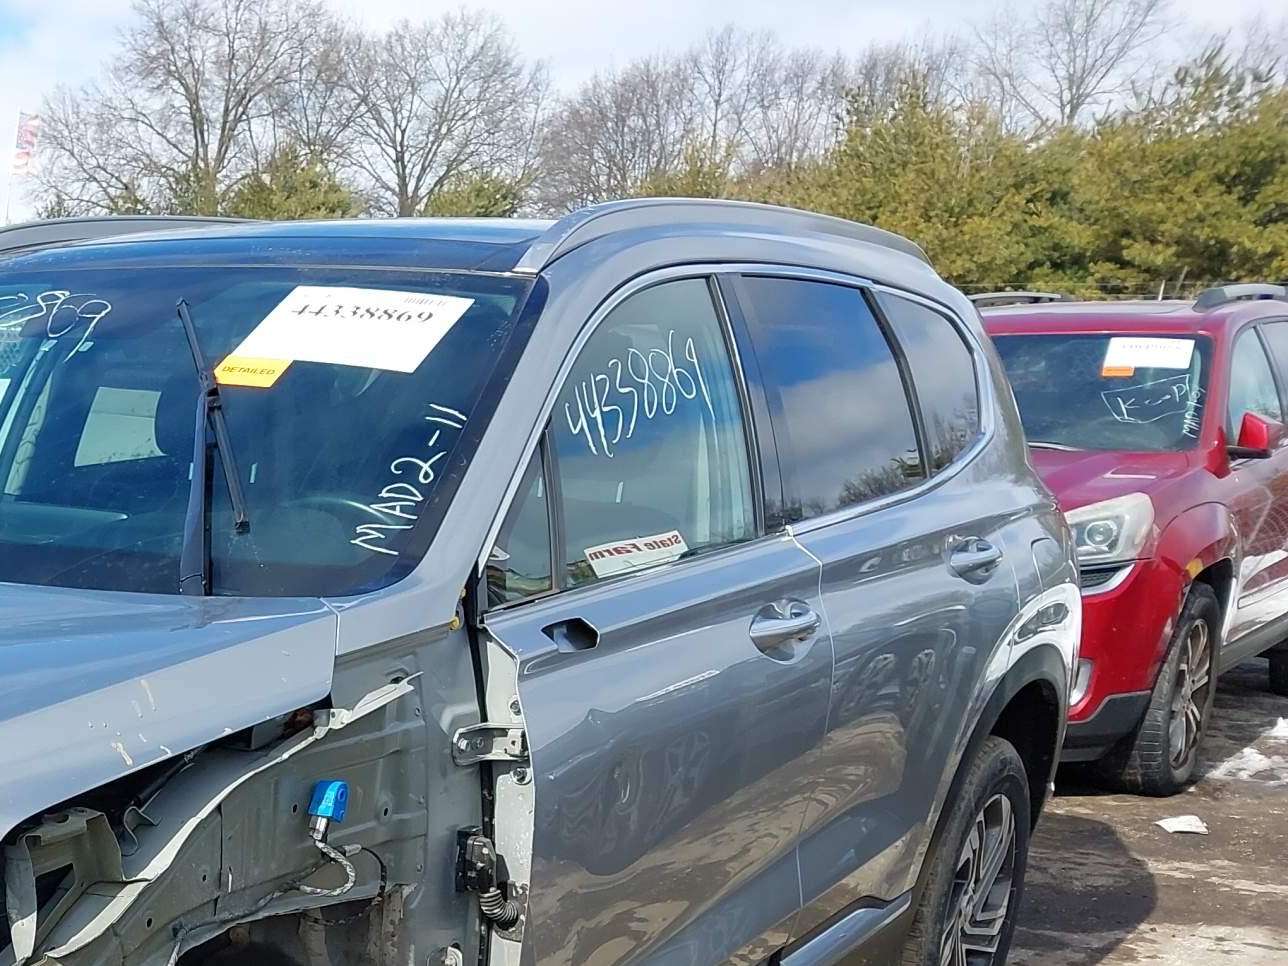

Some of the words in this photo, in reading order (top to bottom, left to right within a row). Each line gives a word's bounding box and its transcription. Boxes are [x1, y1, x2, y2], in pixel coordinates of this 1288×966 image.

[291, 304, 434, 323] 44338869
[222, 365, 276, 376] DETAILED
[565, 329, 718, 458] 44338869
